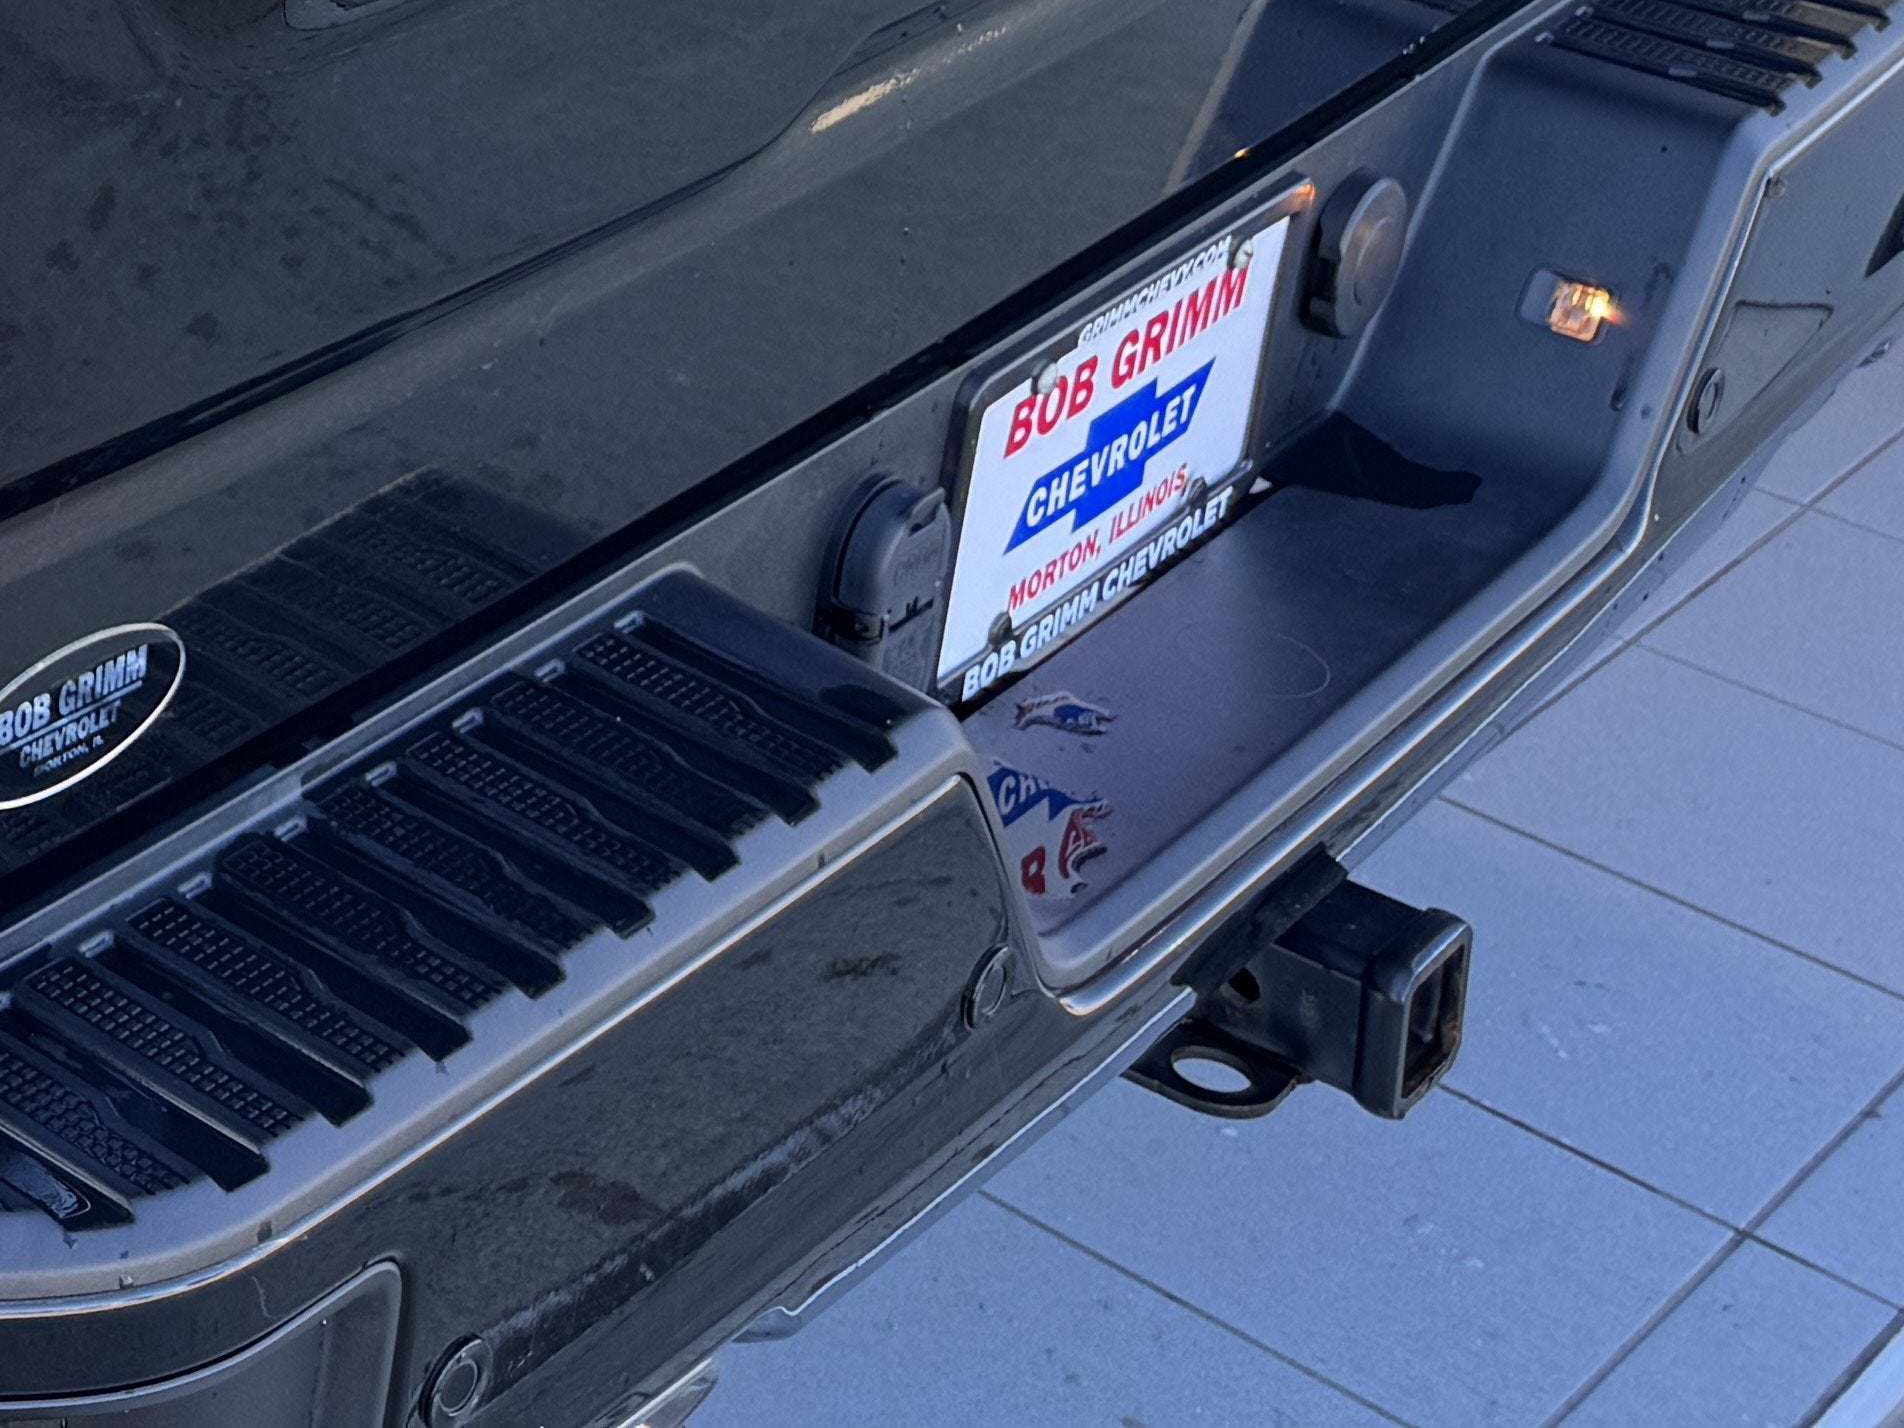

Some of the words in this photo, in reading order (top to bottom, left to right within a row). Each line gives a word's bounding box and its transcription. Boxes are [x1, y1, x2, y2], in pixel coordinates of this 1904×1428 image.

[1081, 235, 1231, 343] GRIMMCHEVY.COM
[1003, 355, 1098, 459] BOB
[1111, 265, 1249, 389] GRIMM
[1026, 384, 1197, 527] CHEVROLET
[962, 640, 1016, 702] BOB
[1020, 581, 1099, 660] GRIMM
[1102, 485, 1233, 601] CHEVROLET
[1008, 529, 1102, 611] MORTON,
[1108, 462, 1187, 544] ILLINOIS
[19, 700, 121, 768] CHEVROLET
[59, 644, 148, 715] GRIMM
